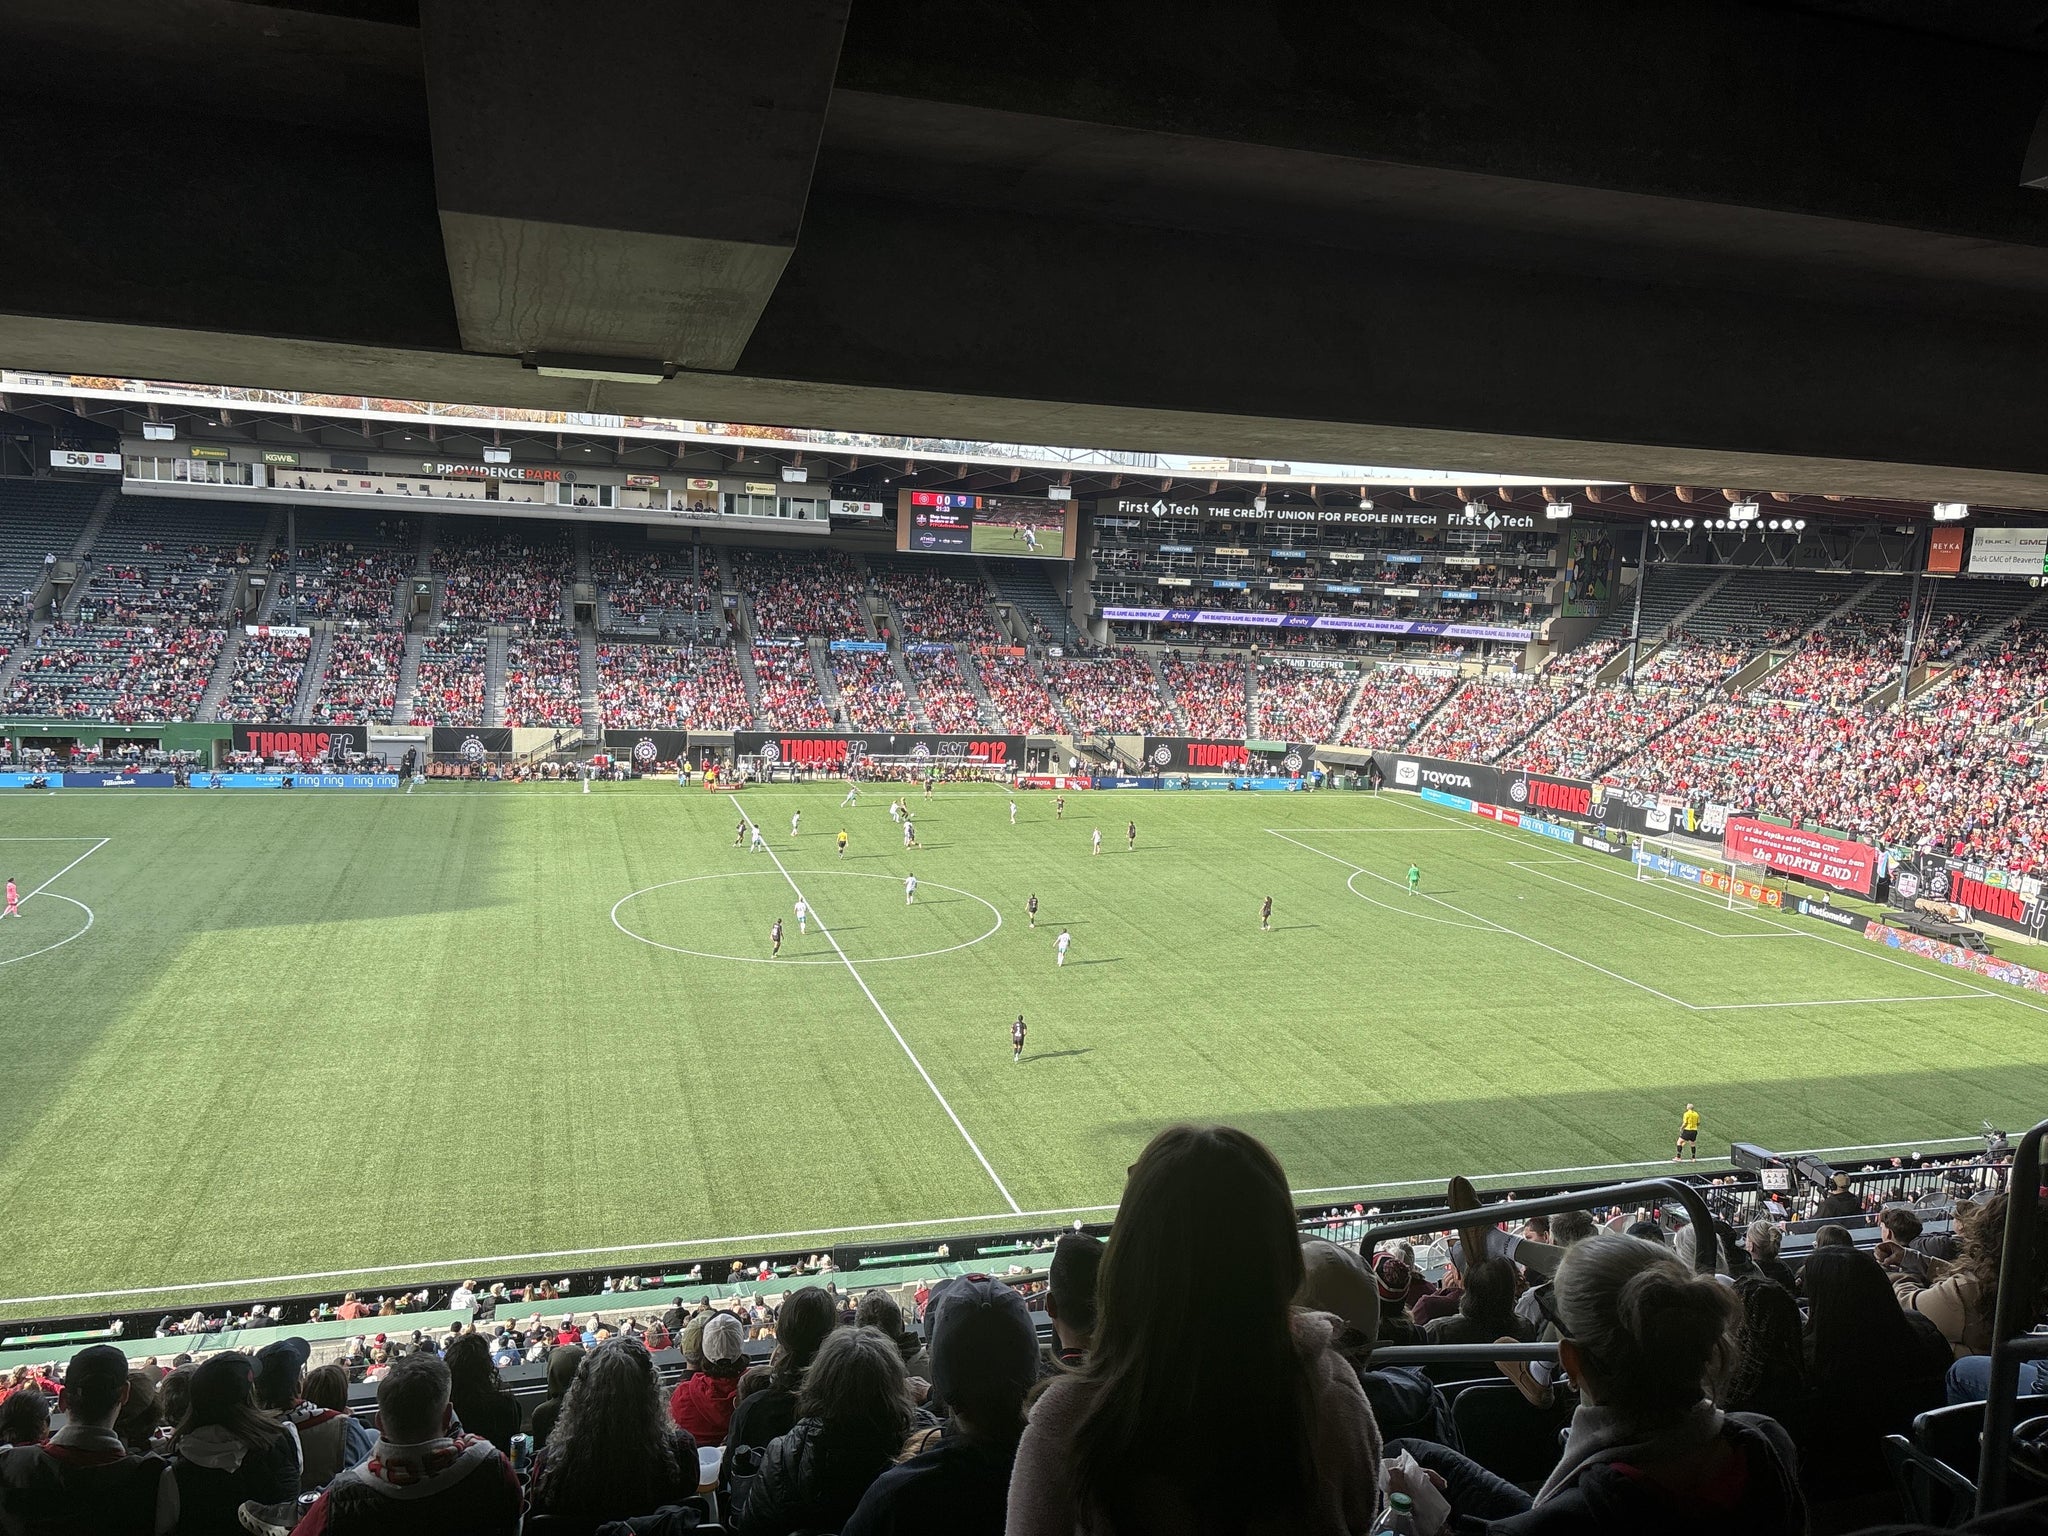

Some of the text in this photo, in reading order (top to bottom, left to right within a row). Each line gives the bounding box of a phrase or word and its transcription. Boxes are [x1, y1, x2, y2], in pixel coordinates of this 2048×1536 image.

[1118, 501, 1199, 515] First Tech
[1208, 507, 1437, 524] THE CREDIT UNION FOR PEOPLE IN TECH
[1447, 514, 1533, 527] First Tech
[2013, 556, 2044, 564] Beaverton
[1171, 611, 1191, 620] xfinity
[1288, 617, 1309, 626] xfinity
[1417, 624, 1438, 633] xfinity
[1307, 659, 1344, 669] TOGETHER
[247, 731, 330, 758] THORNS
[780, 739, 848, 762] THORNS
[937, 741, 1007, 764] EST 2012
[1187, 744, 1249, 766] THORNS
[102, 778, 136, 786] Tillamook
[299, 776, 344, 787] ring ring
[353, 776, 397, 787] ring ring
[1422, 769, 1471, 788] TOYOTA
[1528, 780, 1591, 815] THORNS
[1479, 806, 1494, 815] TOYOTA
[1503, 814, 1518, 823] TOYOTA
[1532, 820, 1543, 833] ring
[1548, 824, 1573, 840] ring ring
[1674, 813, 1726, 835] TYOTA
[1746, 825, 1753, 833] of
[1753, 827, 1763, 835] the
[1763, 830, 1784, 842] depths
[1785, 834, 1792, 842] of
[1792, 836, 1821, 849] SOCCER
[1822, 843, 1840, 854] CITY
[1749, 836, 1781, 849] monstrous
[1782, 844, 1801, 853] sound
[1808, 849, 1821, 859] and
[1828, 856, 1847, 865] came
[1848, 858, 1865, 868] from
[1752, 847, 1860, 882] the NORTH END !
[1951, 870, 2024, 922] THORNS
[1808, 904, 1851, 925] Nationwide
